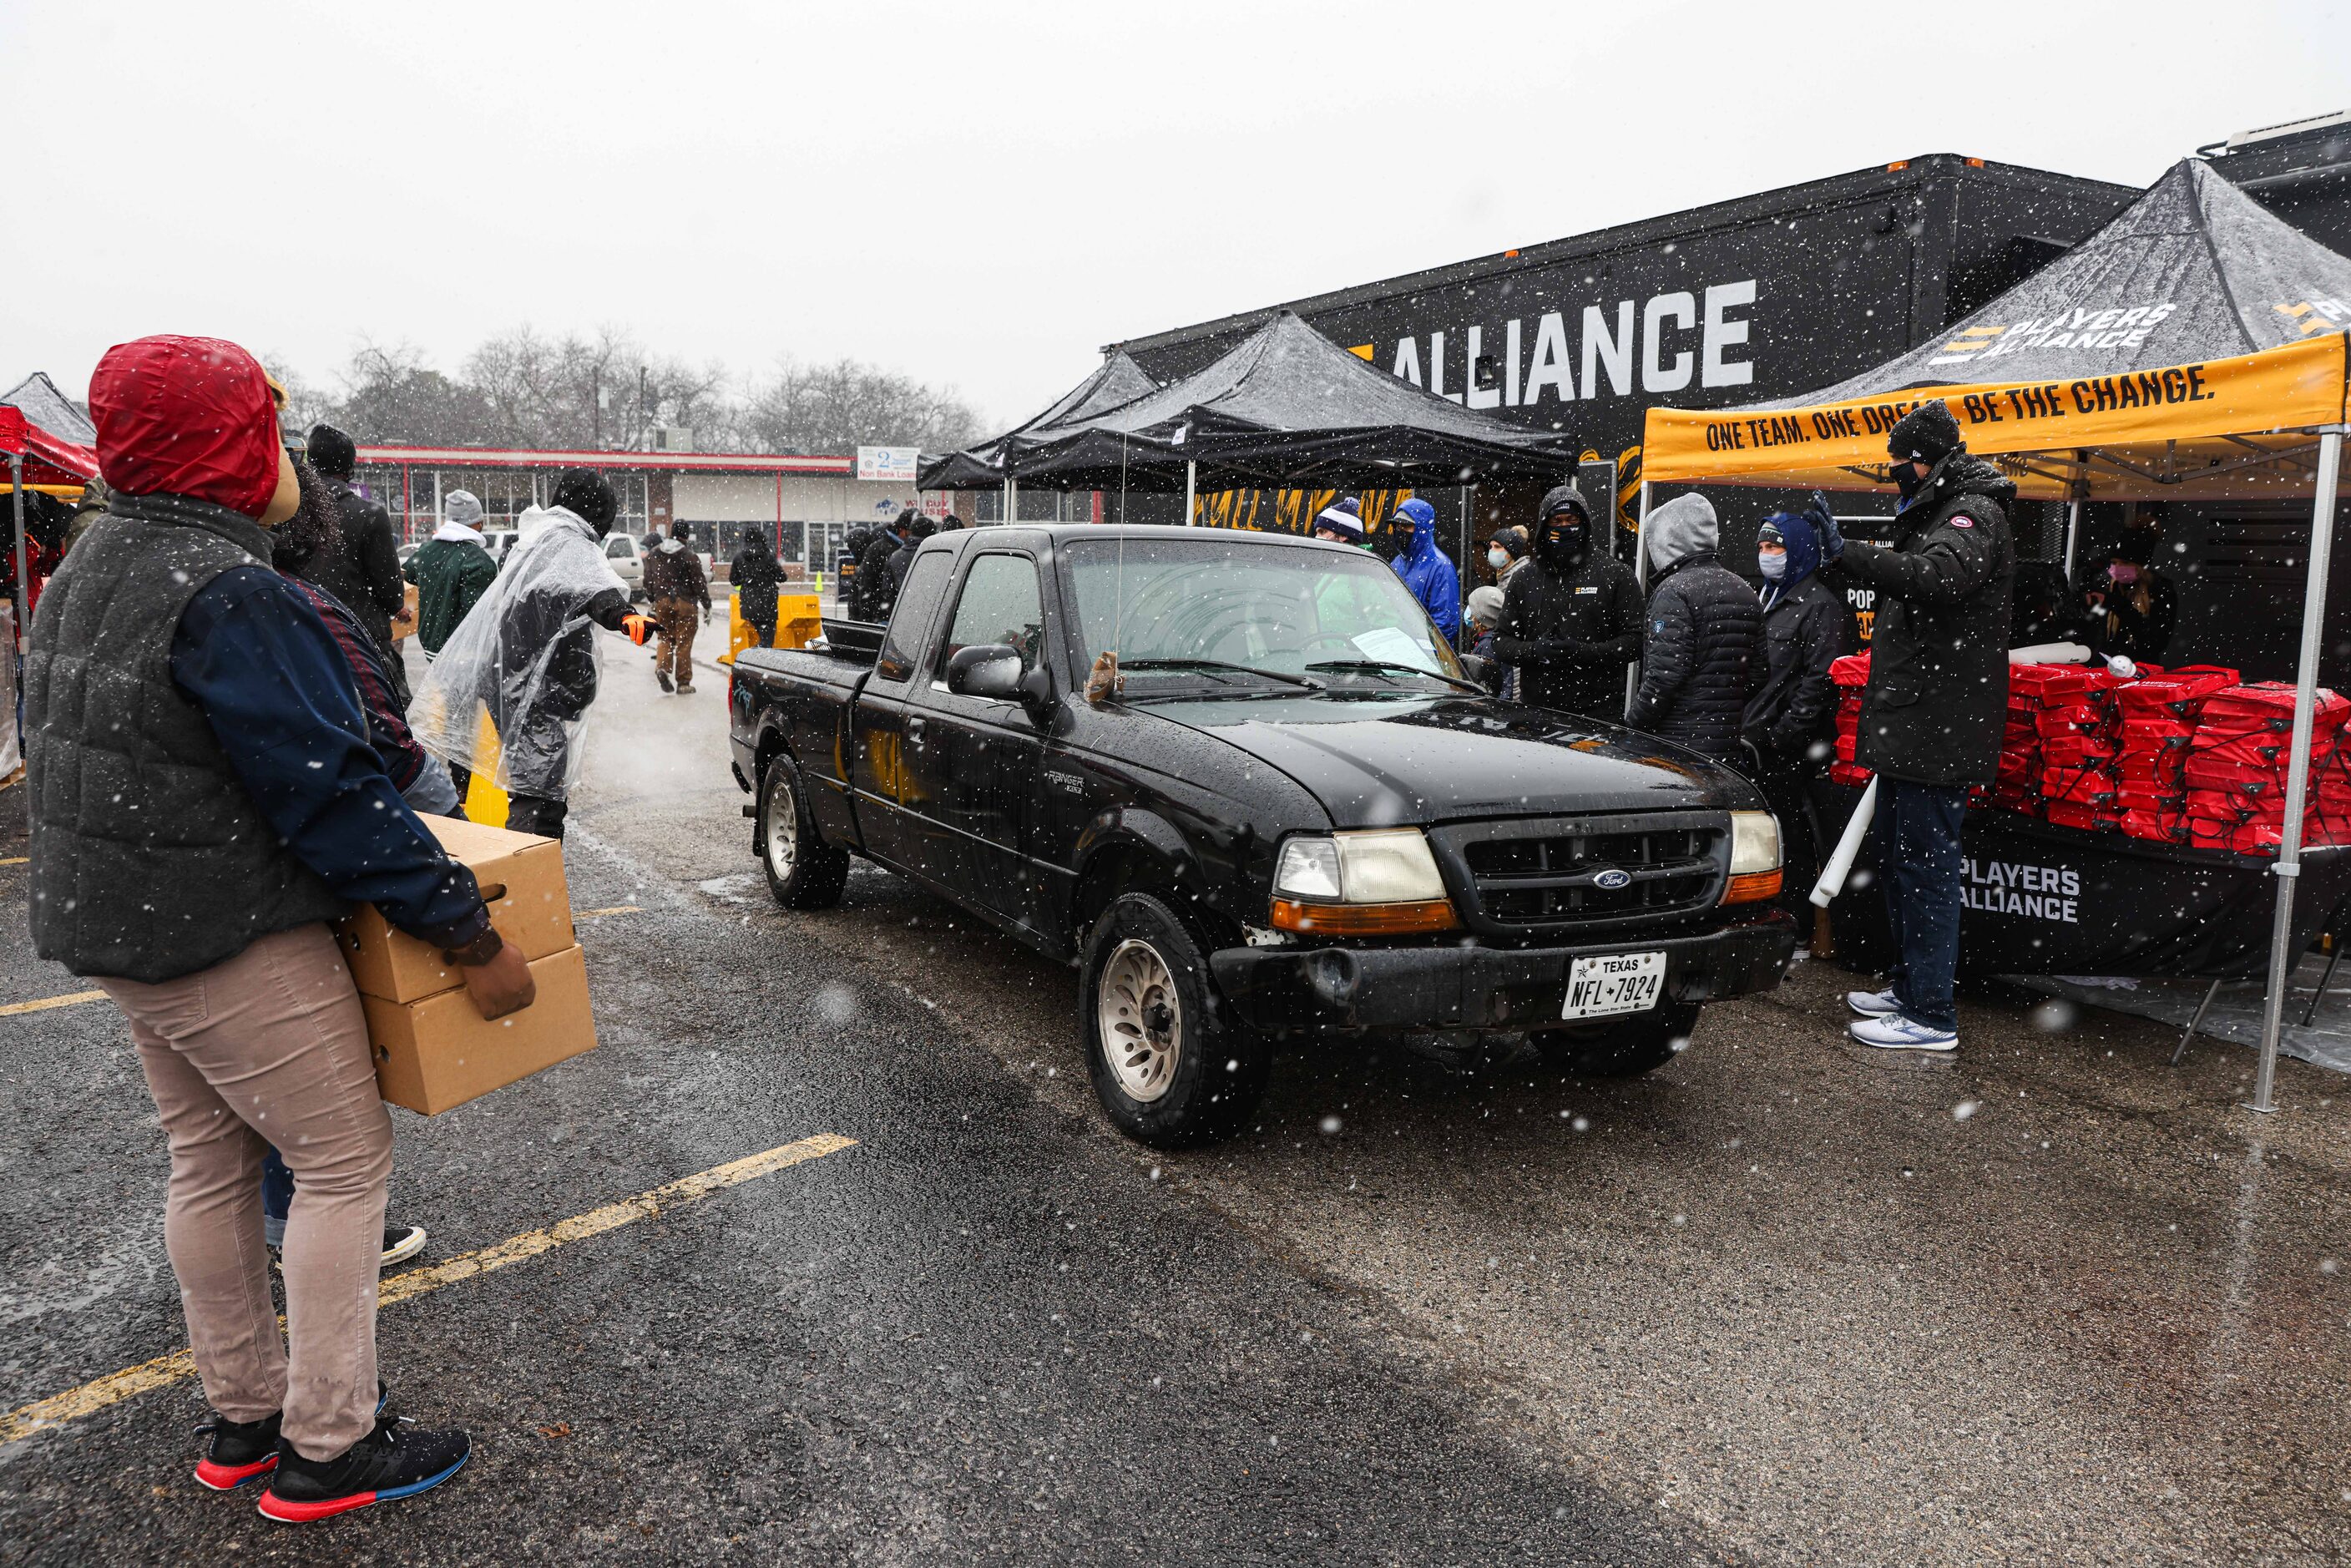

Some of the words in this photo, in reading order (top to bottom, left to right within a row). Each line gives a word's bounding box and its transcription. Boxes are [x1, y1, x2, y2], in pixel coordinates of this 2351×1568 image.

[2000, 302, 2177, 341] PLAYERS
[1393, 280, 1757, 409] ALLIANCE
[1706, 422, 1746, 452] ONE
[1747, 415, 1811, 448] TEAM.
[1812, 408, 1860, 440] ONE
[1862, 398, 1961, 434] DRE.
[1963, 392, 2003, 424] BE
[2005, 384, 2065, 420] THE
[2070, 365, 2215, 414] CHANGE.
[877, 469, 896, 478] Bank
[1048, 770, 1084, 787] RANGER
[1603, 874, 1624, 885] Ford
[1603, 959, 1639, 974] TEXAS
